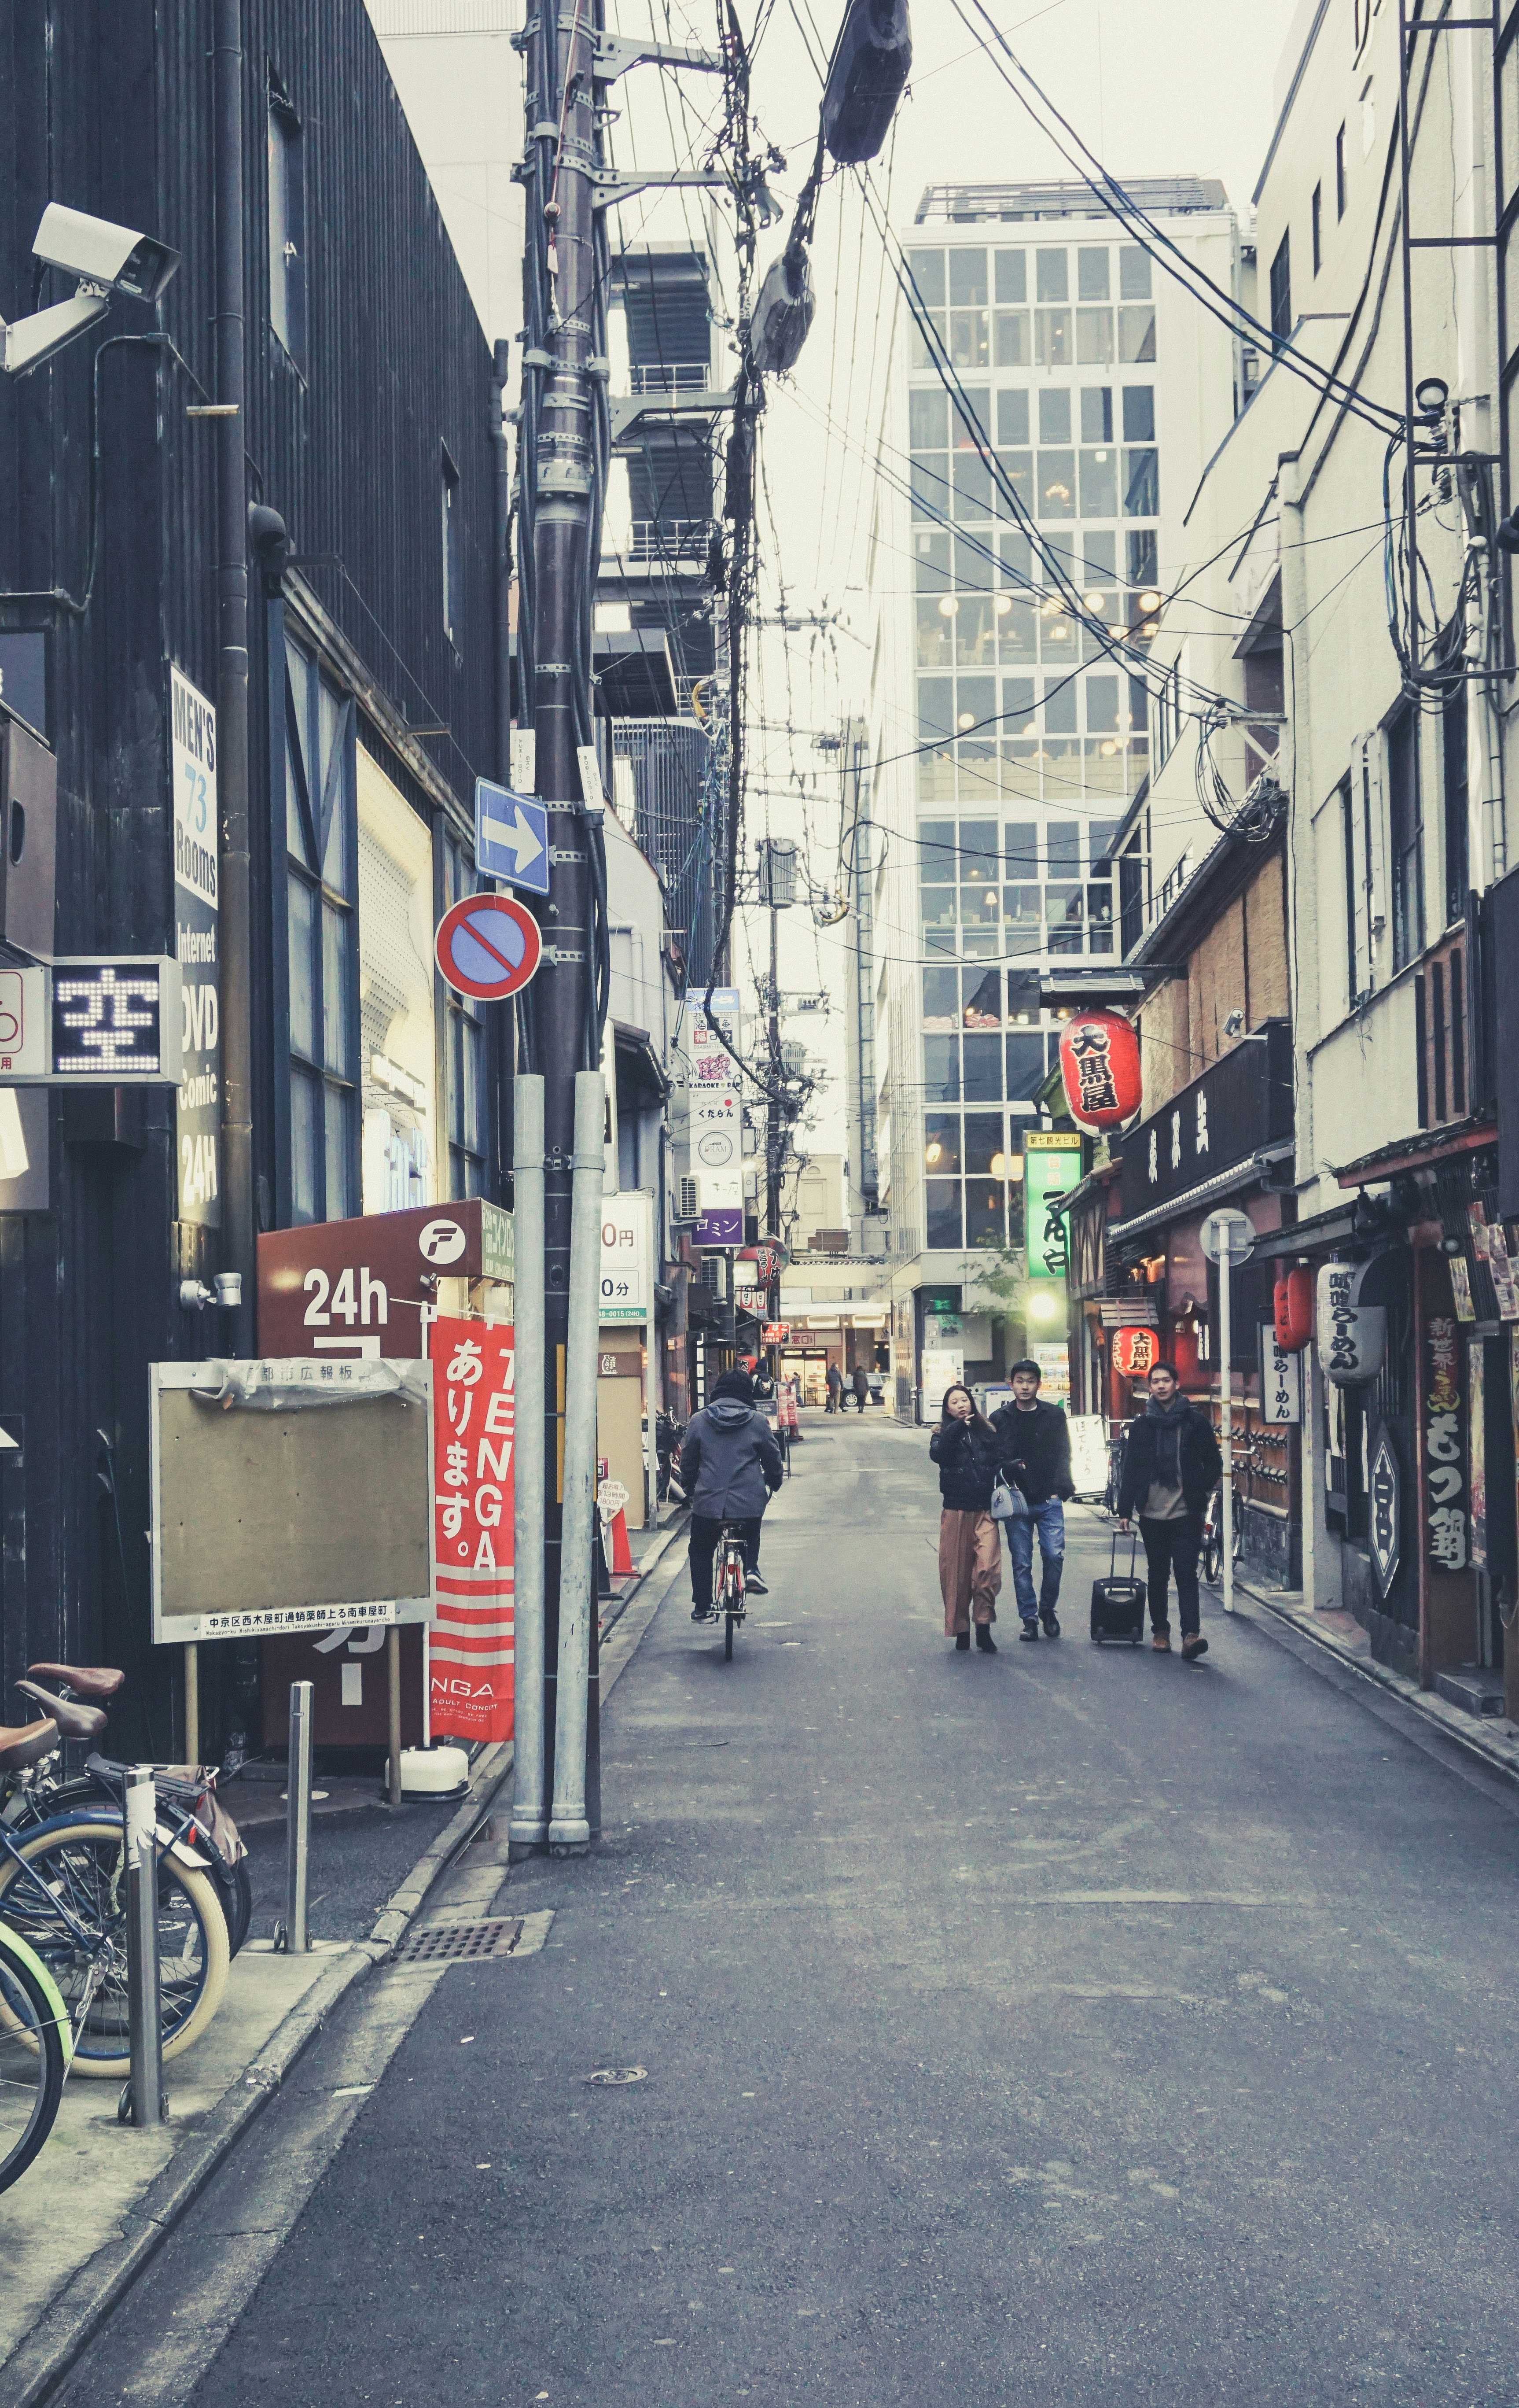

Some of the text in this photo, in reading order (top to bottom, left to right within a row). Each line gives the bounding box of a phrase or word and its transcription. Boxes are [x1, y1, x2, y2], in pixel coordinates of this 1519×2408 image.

[173, 679, 214, 772] MEN'S
[185, 763, 206, 833] 73
[176, 819, 216, 898] Rooms
[177, 922, 215, 963] Internet
[58, 969, 159, 1071] 空
[182, 985, 218, 1052] DVD
[179, 1064, 217, 1110] Comic
[1070, 1024, 1120, 1113] 大黒屋
[699, 1109, 733, 1117] くだらん
[1030, 1136, 1078, 1145] 第七観光ビル
[182, 1134, 217, 1207] 24H
[303, 1267, 388, 1326] 24h
[1273, 1331, 1290, 1419] 噌らーめん
[436, 1339, 483, 1557] あります。
[474, 1348, 514, 1572] TENGA
[1427, 1413, 1466, 1570] もつ鍋
[210, 1605, 387, 1628] 中京区西木屋町通蛸薬師上る南車屋町
[431, 1677, 494, 1698] NGA
